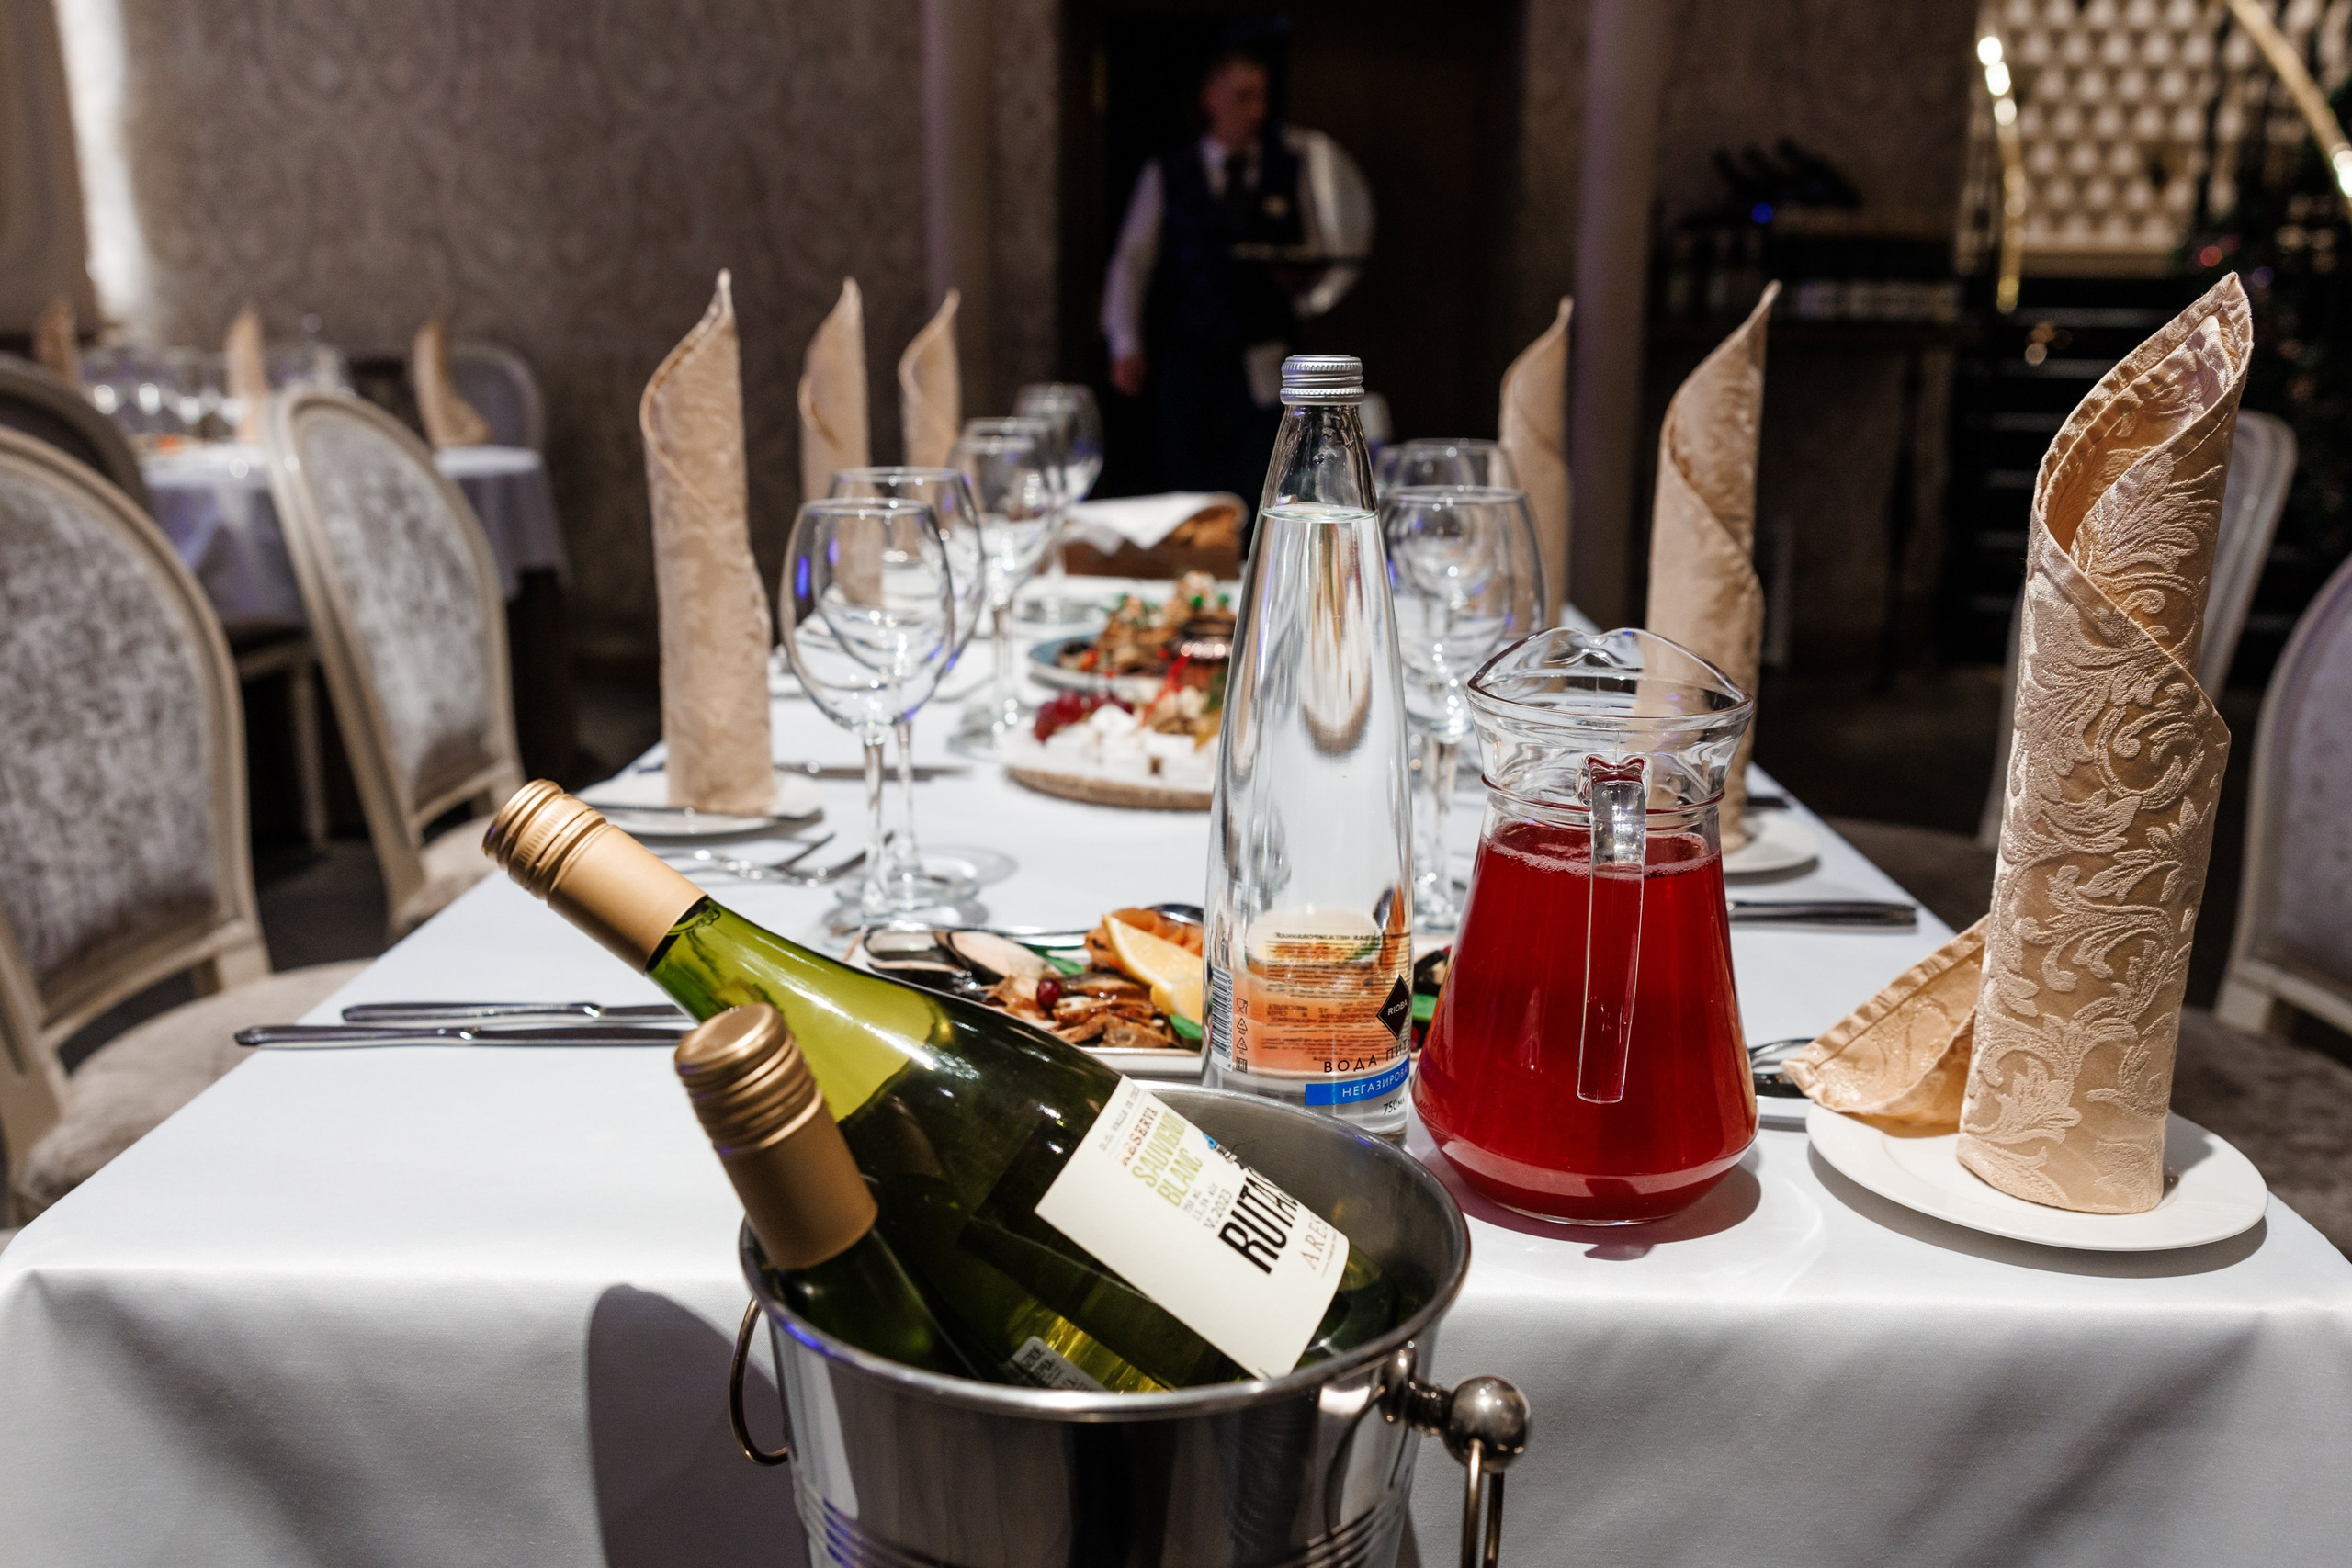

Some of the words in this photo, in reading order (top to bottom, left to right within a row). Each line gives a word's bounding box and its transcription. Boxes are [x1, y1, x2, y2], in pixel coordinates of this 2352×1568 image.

[1387, 998, 1408, 1016] RIOBA
[1324, 1055, 1377, 1073] ВОДА
[1385, 1038, 1411, 1062] ПИТ
[1342, 1066, 1410, 1097] НЕГАЗИРОВА
[1117, 1107, 1158, 1167] RESERVA
[1132, 1111, 1187, 1187] SAUVIGNON
[1156, 1146, 1204, 1207] BLANC
